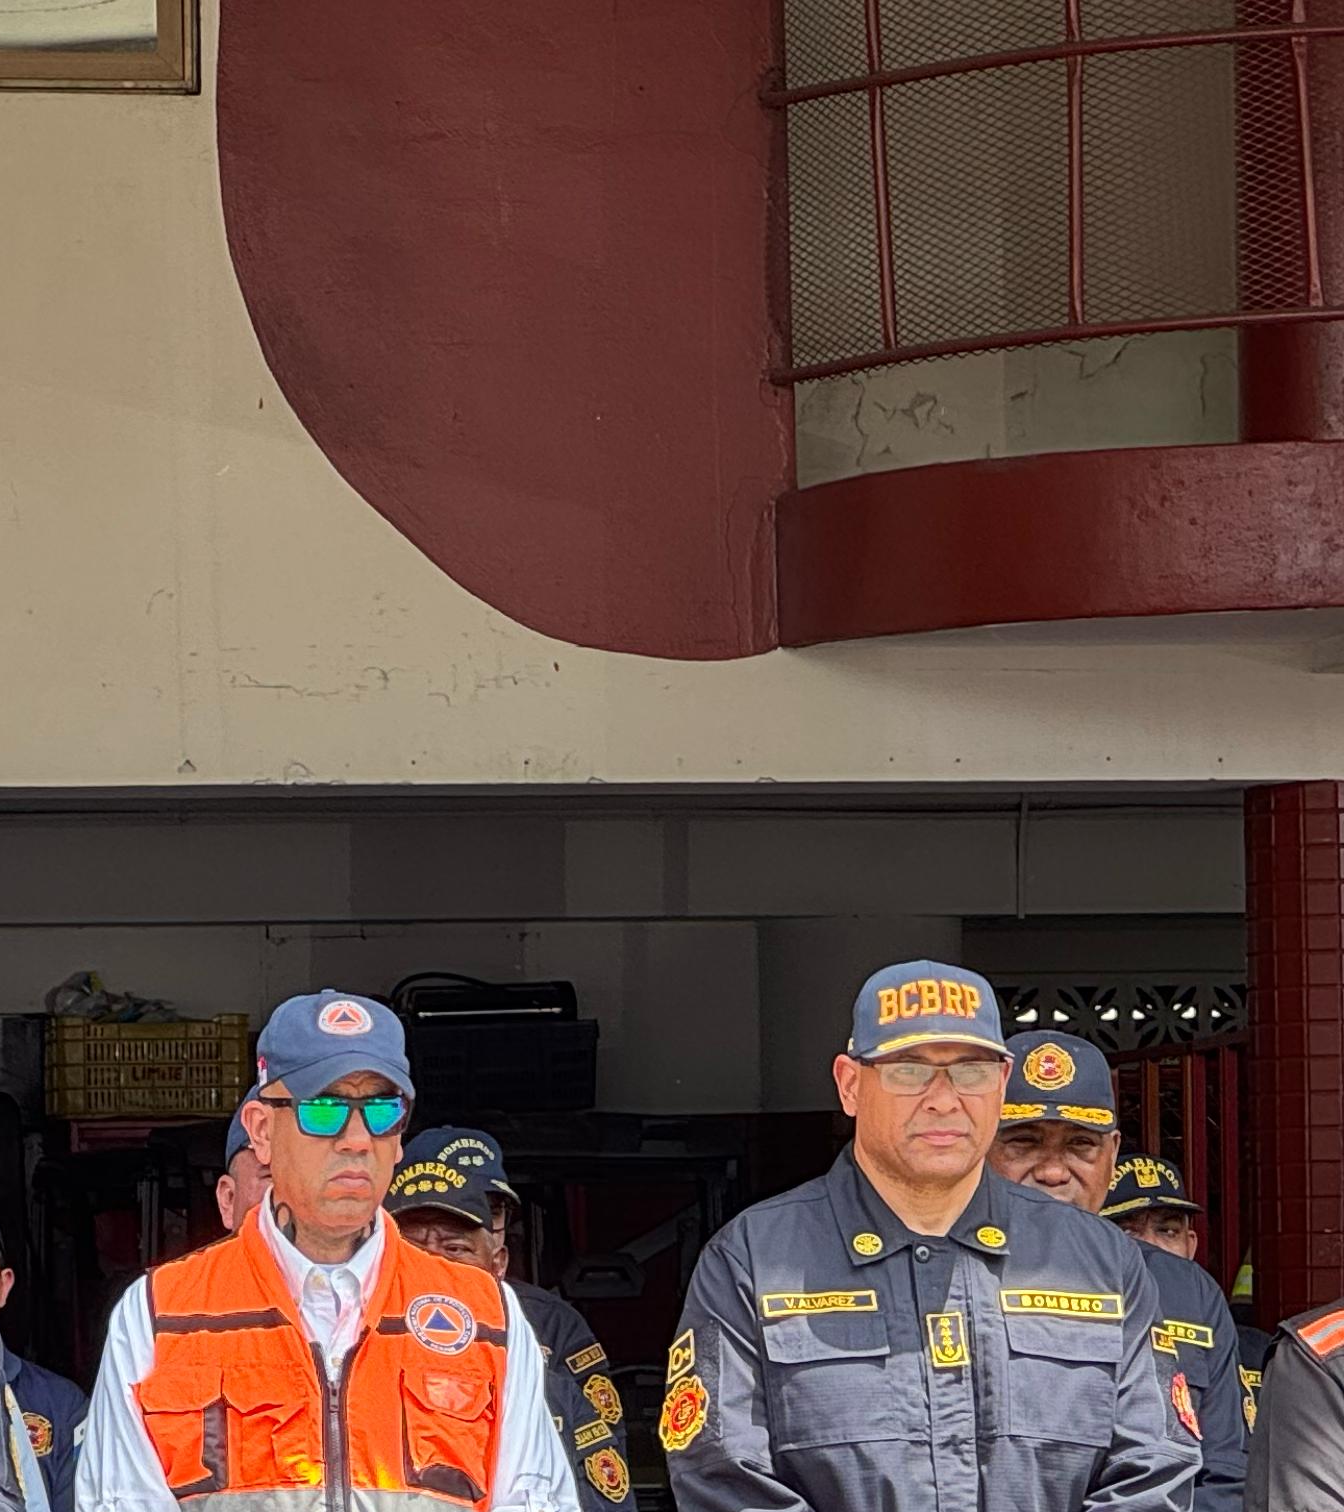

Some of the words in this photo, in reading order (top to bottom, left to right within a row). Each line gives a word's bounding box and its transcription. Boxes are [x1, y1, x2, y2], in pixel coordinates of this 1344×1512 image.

[878, 979, 981, 1025] BCBRP
[437, 1138, 495, 1162] BOMBEROS
[389, 1162, 467, 1196] BOMBEROS
[1108, 1157, 1180, 1192] BOMBEROS
[798, 1295, 856, 1309] ALVAREZ
[1020, 1294, 1103, 1312] BOMBERO
